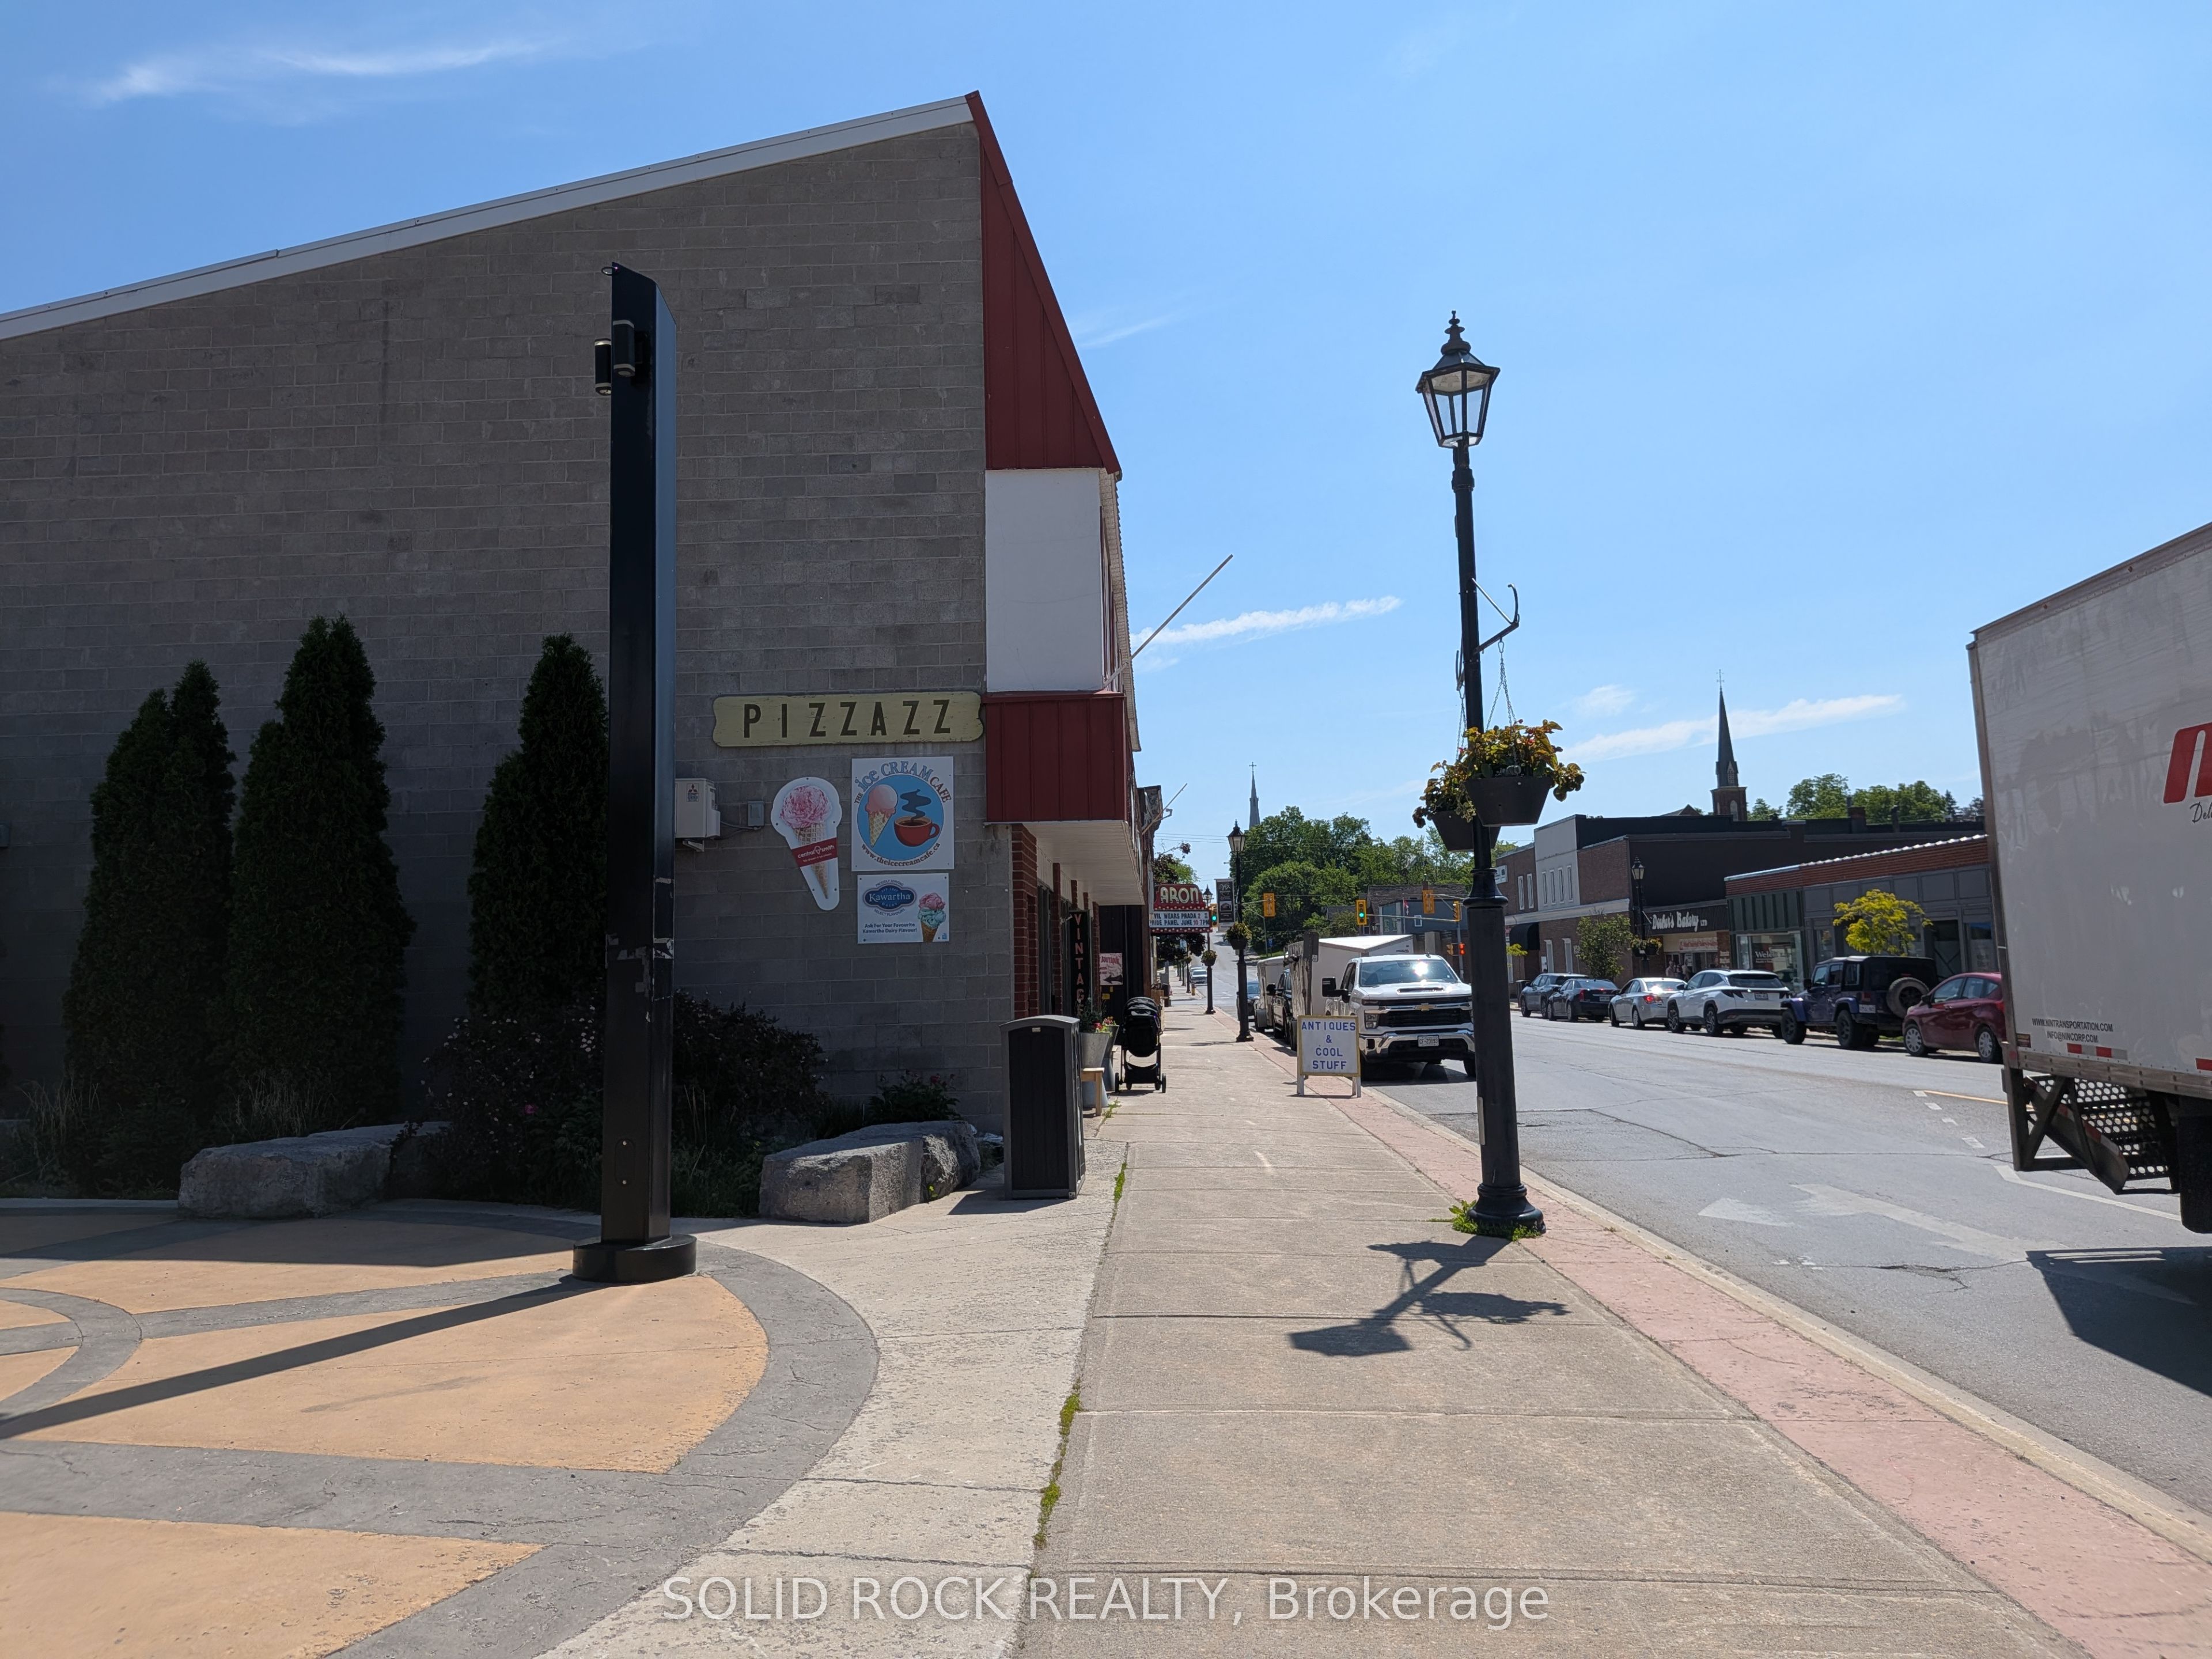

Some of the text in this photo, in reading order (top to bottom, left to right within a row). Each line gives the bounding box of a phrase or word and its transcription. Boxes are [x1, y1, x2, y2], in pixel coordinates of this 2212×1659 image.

[743, 699, 952, 738] PIZZAZZ
[854, 792, 864, 804] THE
[880, 760, 934, 782] CREAM
[929, 776, 952, 803] CAFE
[2189, 801, 2212, 824] Del
[861, 842, 941, 867] www.theicecreamcafe.ca
[869, 893, 911, 903] Kawartha
[1160, 887, 1199, 904] ARON
[1676, 911, 1699, 932] Bakery
[1074, 914, 1084, 1017] VINTAGE
[1301, 1021, 1356, 1031] ANTIQUES
[2032, 1018, 2113, 1032] WWW.NINTRANSPORTATION.COM
[1325, 1035, 1332, 1043] &
[2046, 1030, 2099, 1043] INFO@NINCORP.COM
[1316, 1047, 1343, 1056] COOL
[1312, 1060, 1347, 1070] STUFF
